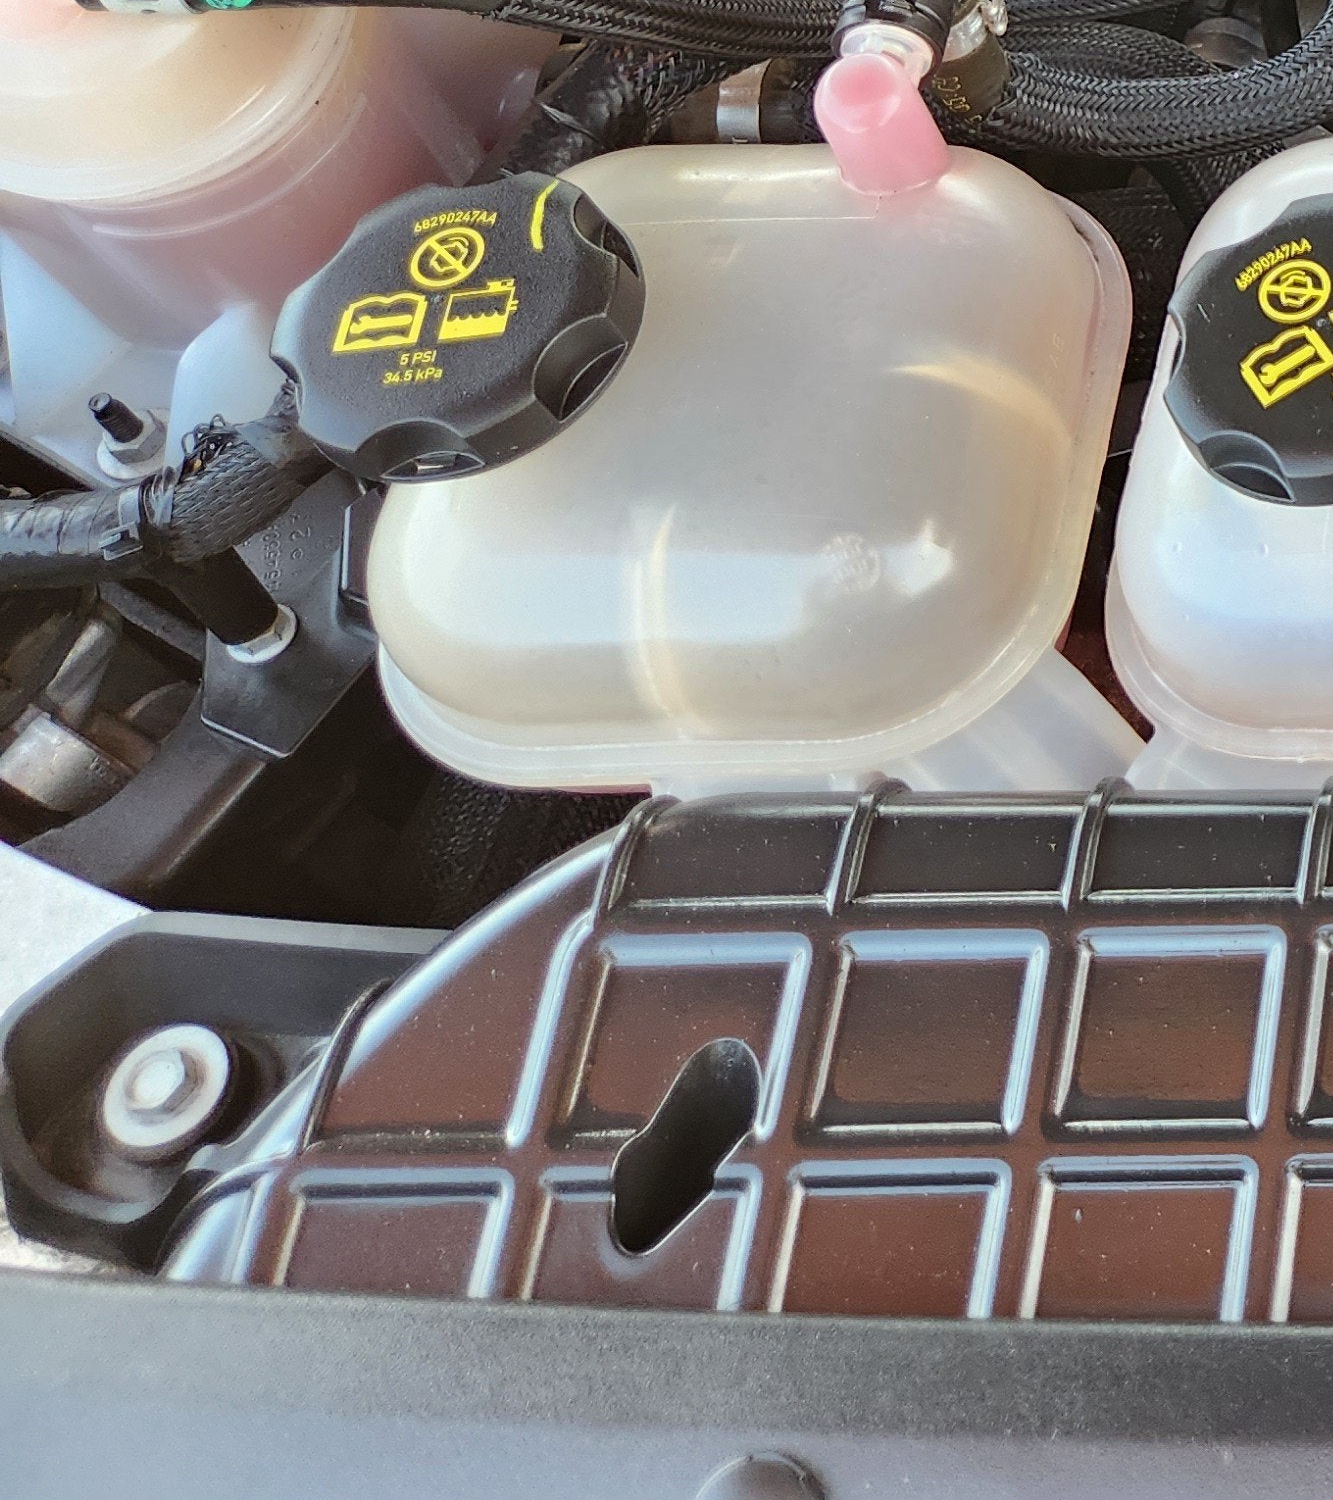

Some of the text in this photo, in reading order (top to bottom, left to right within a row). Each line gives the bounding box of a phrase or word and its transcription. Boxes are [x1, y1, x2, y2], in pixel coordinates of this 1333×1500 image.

[414, 210, 498, 234] 68290247AA
[1234, 237, 1312, 292] 68290247AA
[400, 350, 437, 366] 5 PSI
[383, 368, 443, 385] 34.5 kPa
